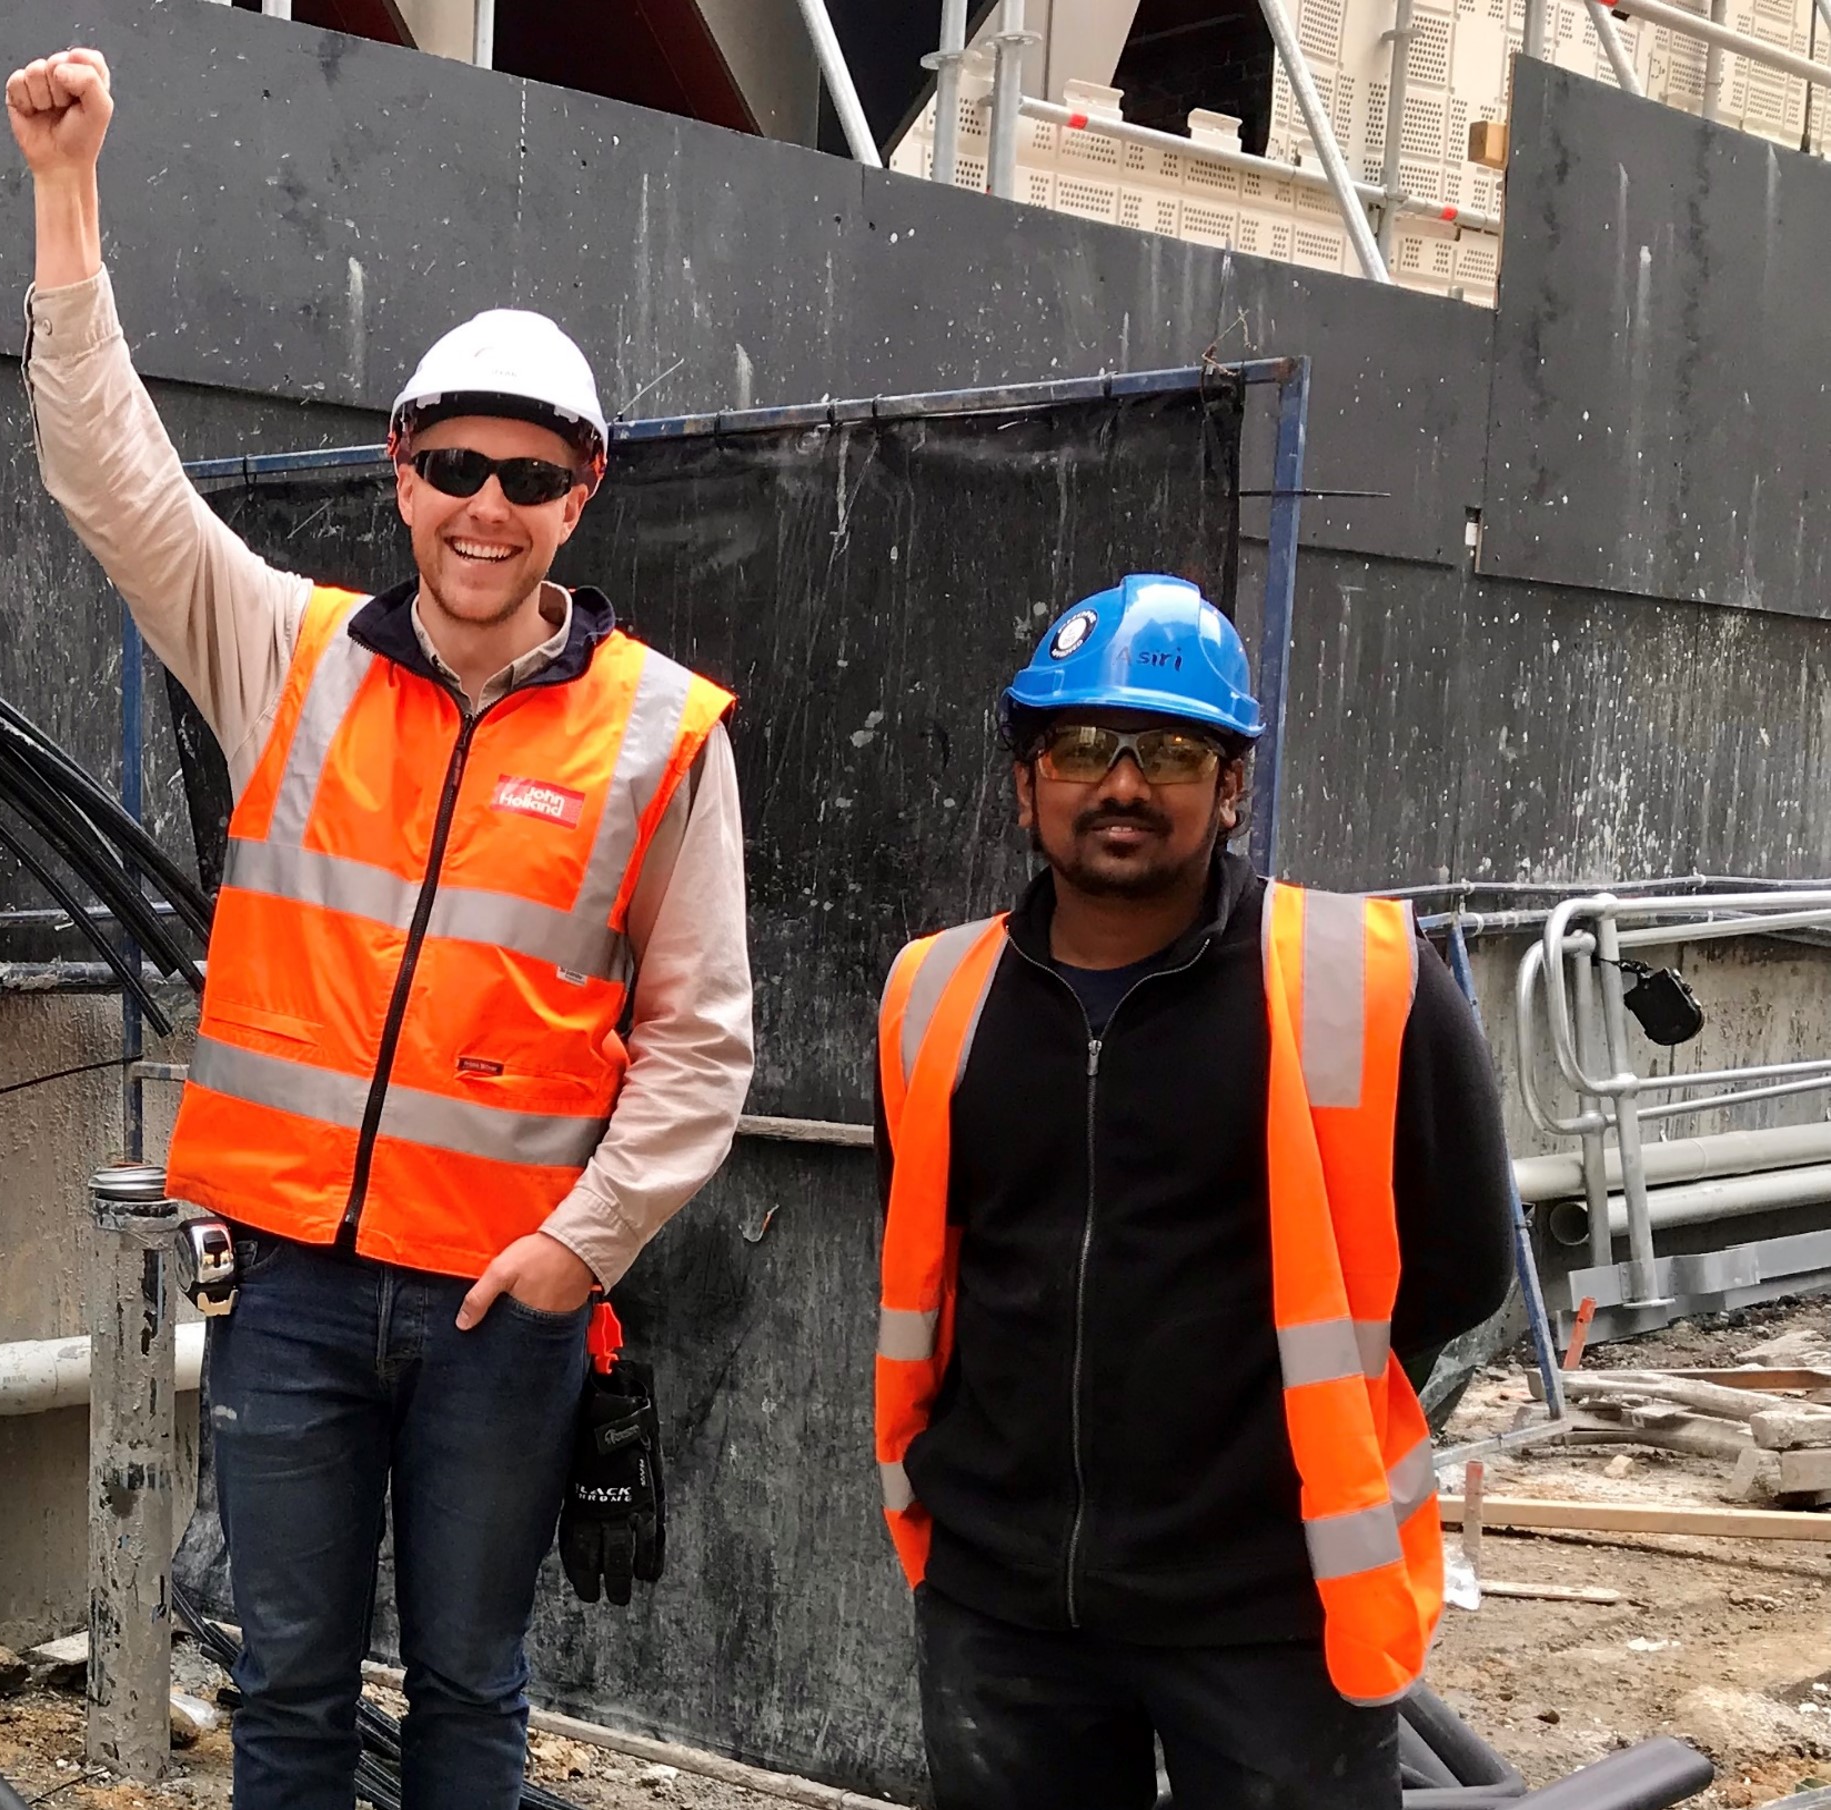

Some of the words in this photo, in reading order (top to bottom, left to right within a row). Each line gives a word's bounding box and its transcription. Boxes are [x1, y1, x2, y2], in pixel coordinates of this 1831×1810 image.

[528, 786, 565, 802] John
[499, 792, 565, 817] Holland
[578, 1493, 632, 1502] HROME
